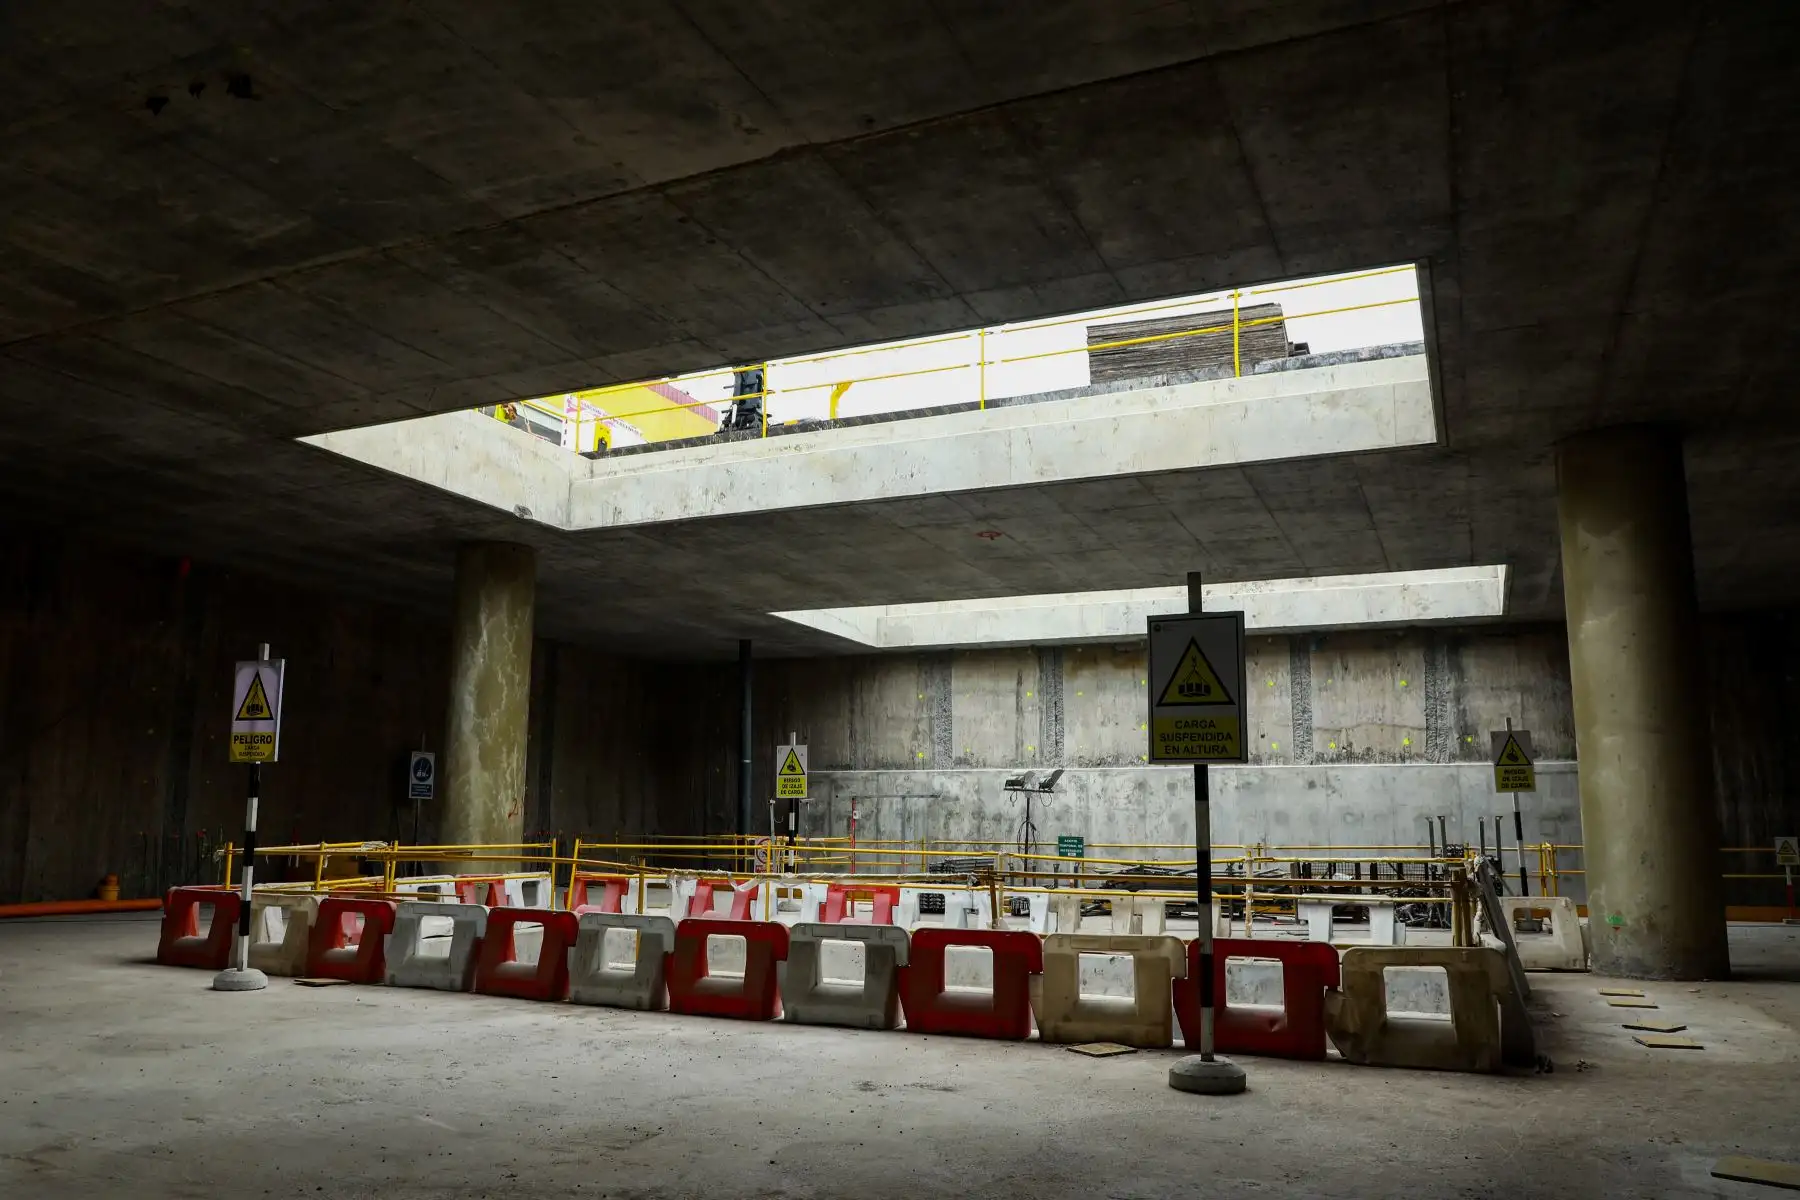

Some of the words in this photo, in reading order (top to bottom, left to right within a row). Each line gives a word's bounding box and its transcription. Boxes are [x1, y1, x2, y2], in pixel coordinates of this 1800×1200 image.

[1175, 720, 1216, 729] CARGA
[234, 735, 272, 744] PELIGRO
[1160, 732, 1233, 742] SUSPENDIDA
[1165, 745, 1180, 754] EN
[1183, 745, 1228, 754] ALTURA
